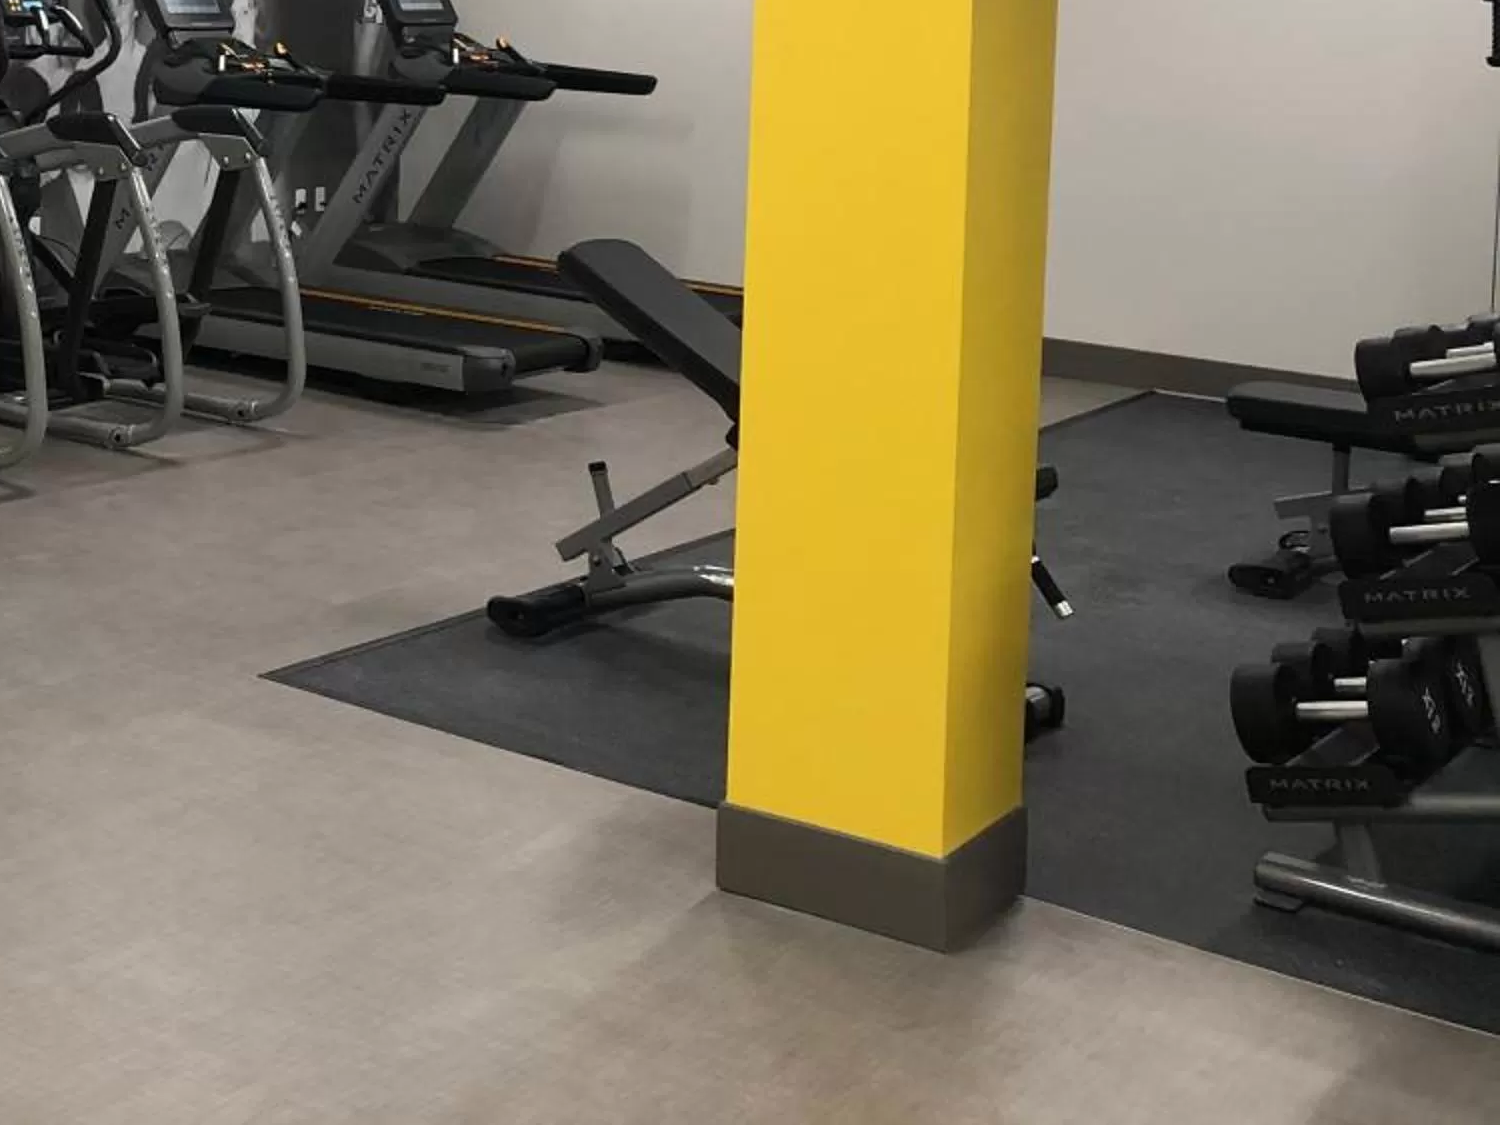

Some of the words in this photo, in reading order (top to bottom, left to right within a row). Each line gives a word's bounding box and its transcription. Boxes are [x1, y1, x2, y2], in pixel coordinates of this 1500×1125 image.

[351, 108, 412, 204] MATRIX
[1363, 586, 1471, 604] MATRIX
[1268, 778, 1370, 793] MATRIX
